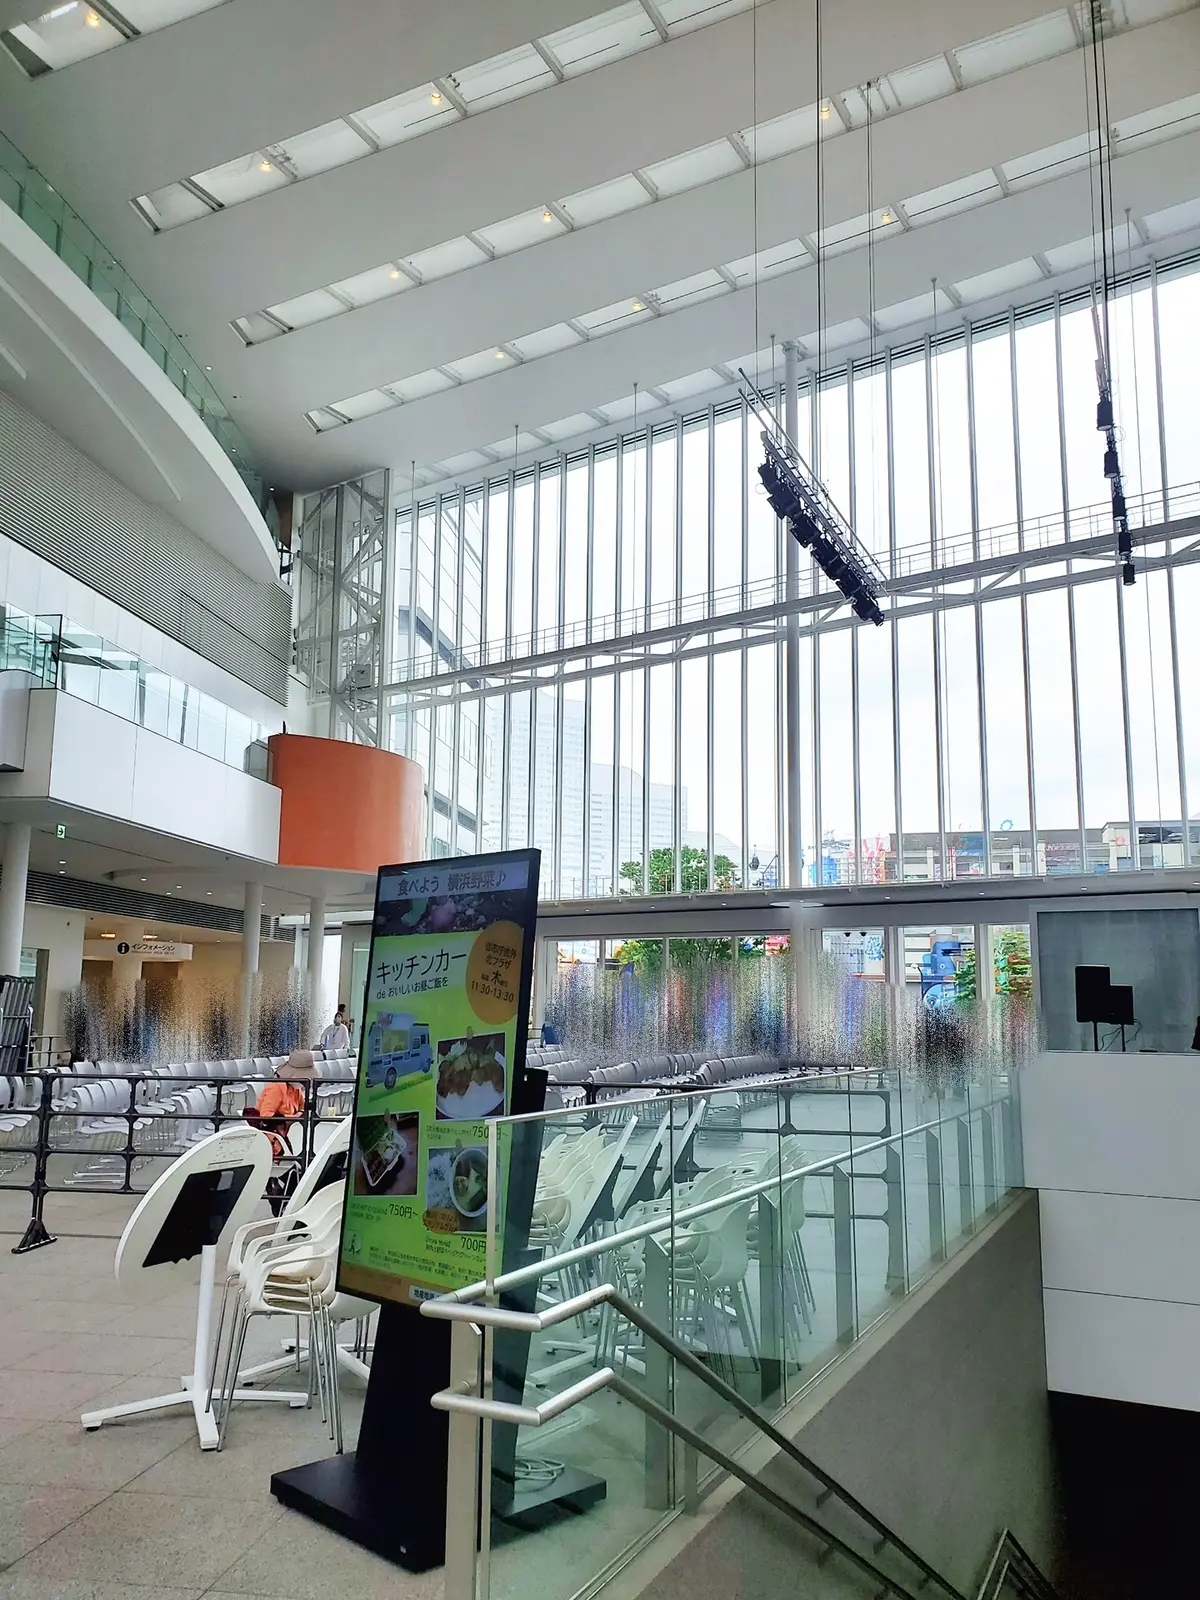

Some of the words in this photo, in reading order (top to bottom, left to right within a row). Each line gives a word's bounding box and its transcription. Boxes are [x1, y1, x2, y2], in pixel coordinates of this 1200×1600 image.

[397, 876, 439, 896] 食べよう
[131, 943, 175, 951] インフォメーション
[376, 948, 467, 985] キッチンカー
[376, 989, 386, 1000] de
[471, 980, 514, 1003] 11:30-13:30
